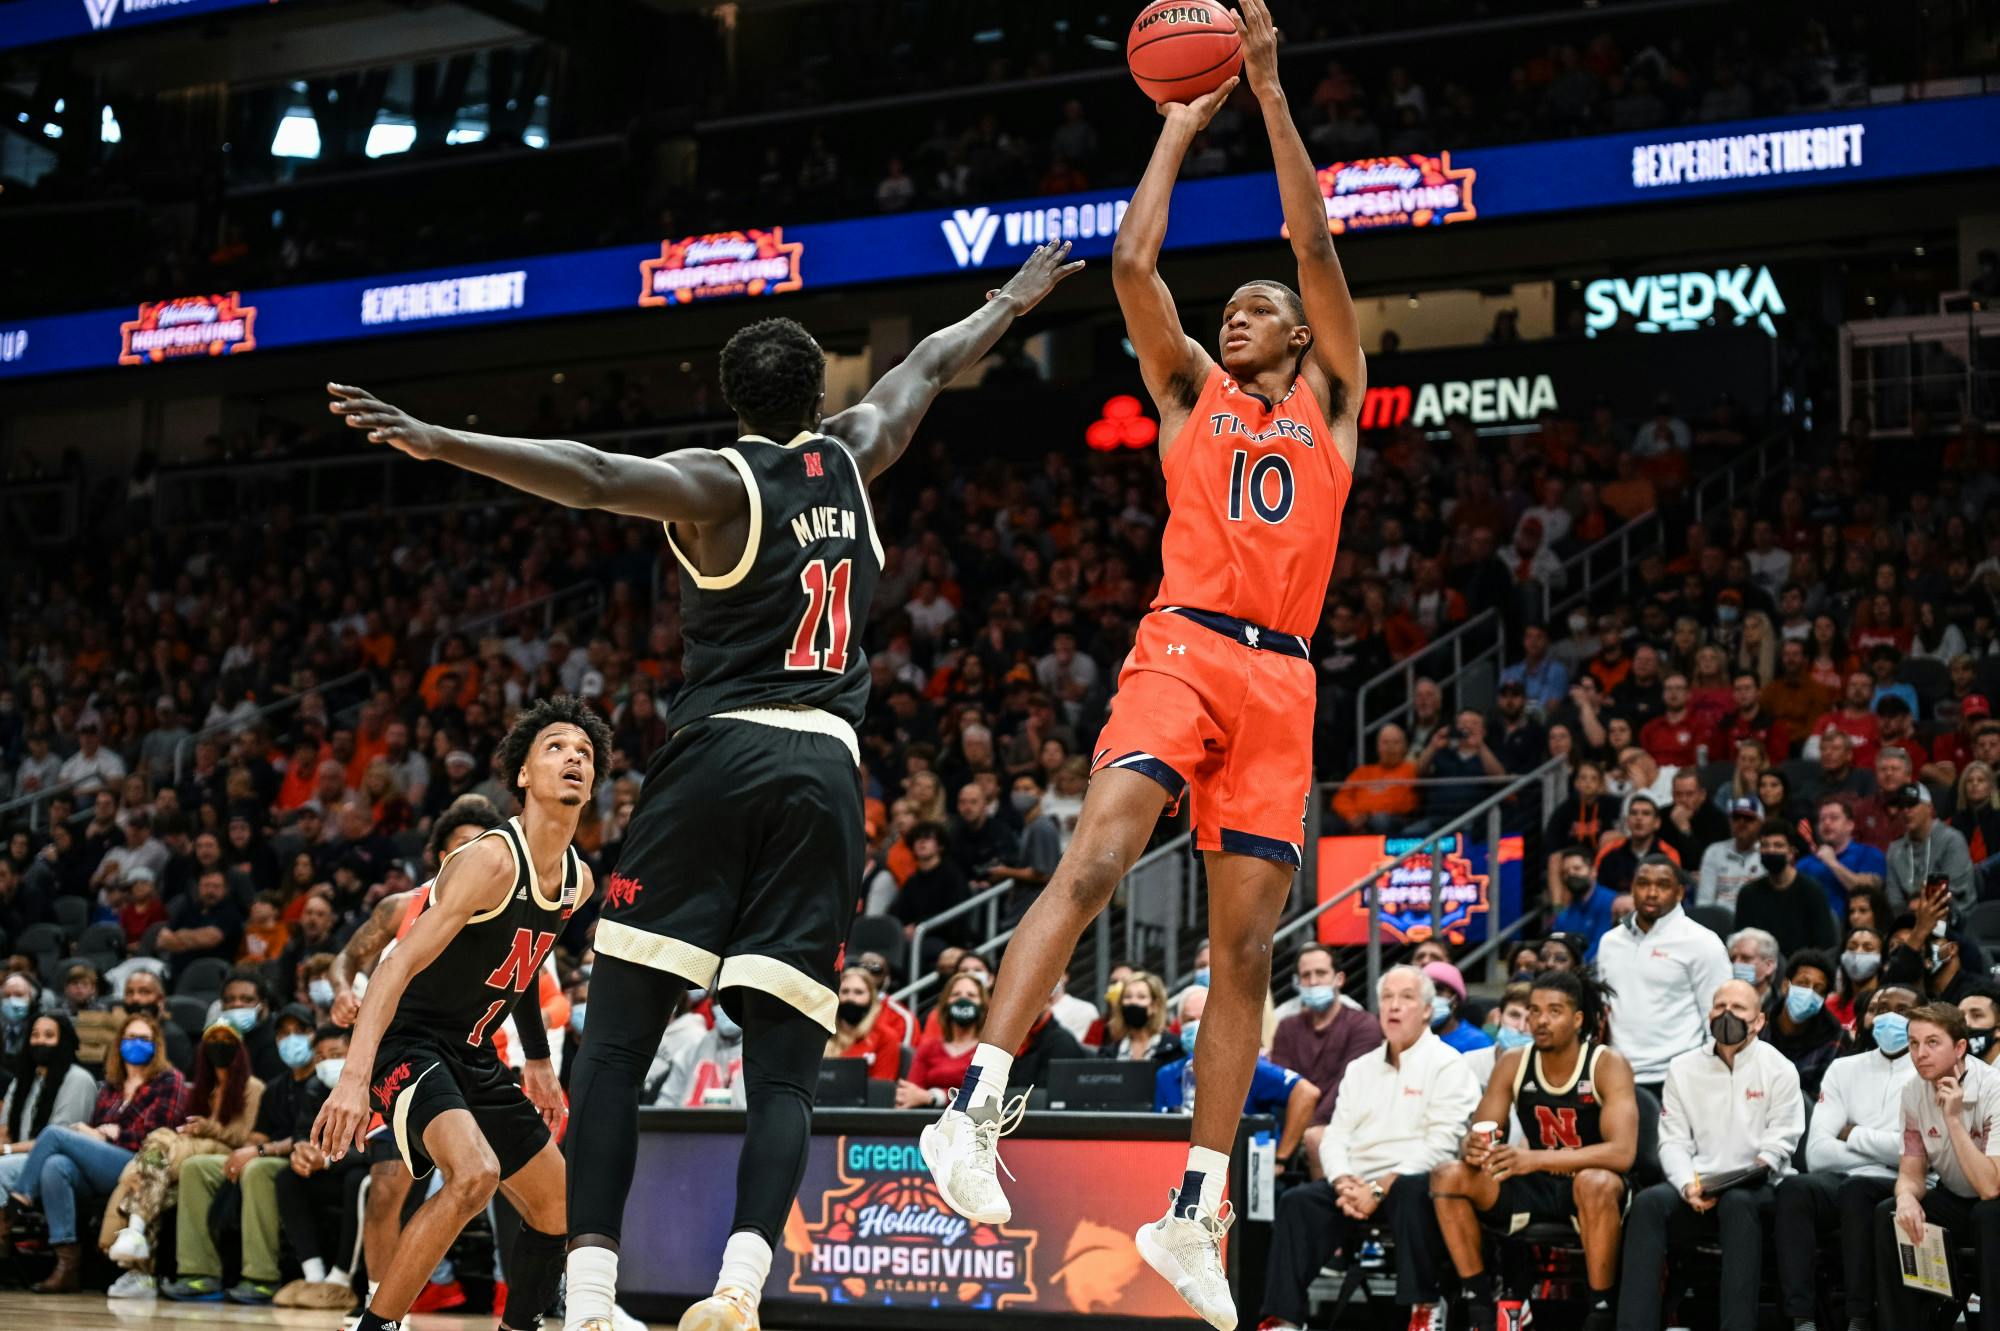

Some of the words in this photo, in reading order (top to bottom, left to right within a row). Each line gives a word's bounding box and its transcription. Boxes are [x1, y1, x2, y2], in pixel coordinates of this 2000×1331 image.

[1137, 7, 1214, 32] Wilson
[1632, 124, 1865, 188] #EXPERIENCETHEGIFT
[1335, 163, 1421, 194] Holiday
[1584, 265, 1787, 338] SVEDKA
[1413, 374, 1559, 427] ARENA
[1210, 412, 1315, 449] TIGERS
[803, 451, 824, 478] N
[1227, 449, 1295, 525] 10
[790, 506, 857, 549] MAYEN
[784, 558, 852, 674] 11
[485, 927, 556, 993] N
[465, 1000, 507, 1048] 1
[1534, 1104, 1582, 1148] N
[858, 1203, 967, 1246] Holiday
[811, 1244, 1016, 1280] HOOPSGIVING
[874, 1278, 949, 1293] ATLANTA
